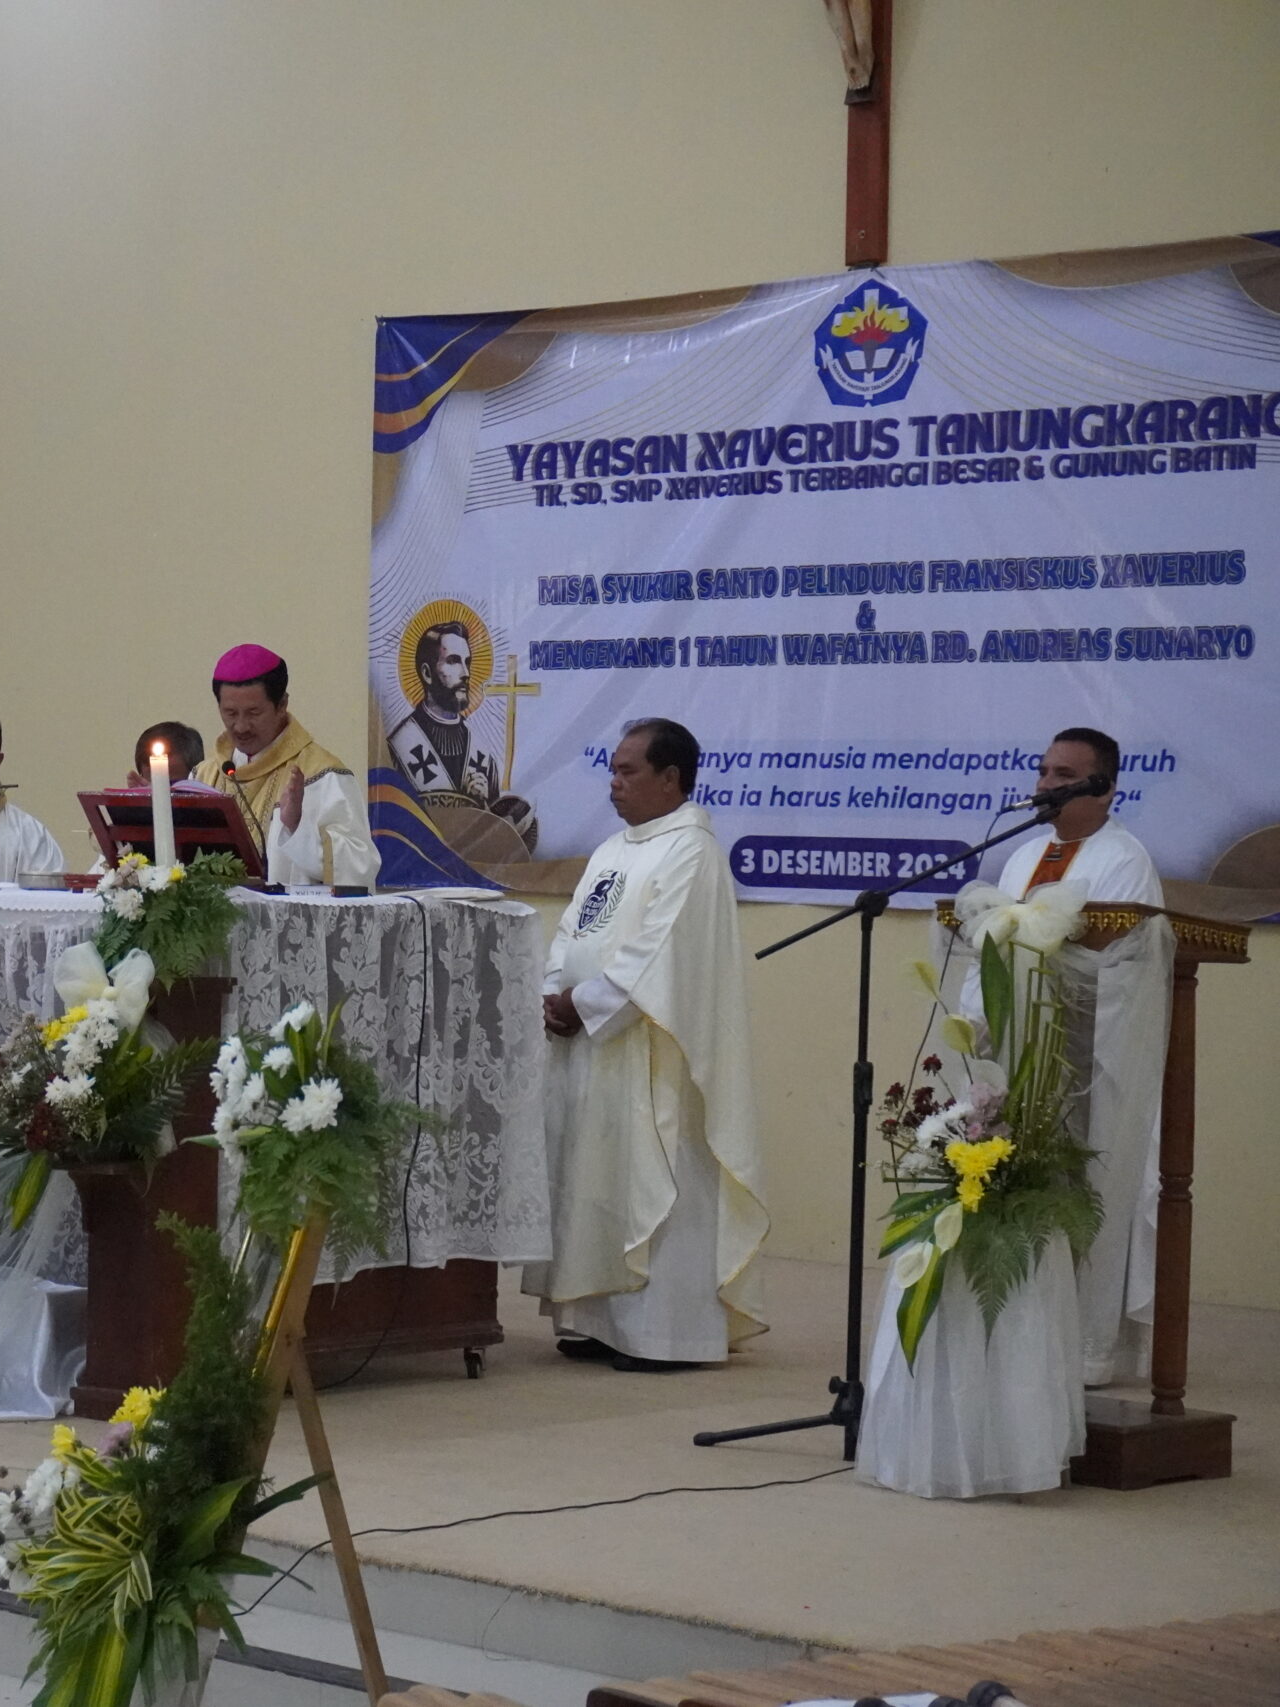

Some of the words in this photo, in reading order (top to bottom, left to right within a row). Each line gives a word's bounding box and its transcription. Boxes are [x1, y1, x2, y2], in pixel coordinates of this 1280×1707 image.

[505, 433, 688, 481] YAYASAN
[695, 418, 900, 472] XAVERIUS
[610, 478, 663, 503] SMP
[665, 470, 783, 501] XAVERIUS
[786, 461, 929, 493] TERBANGGI
[931, 457, 1020, 485] BESAR
[1024, 455, 1045, 480] &
[1050, 449, 1167, 478] GUNUNG
[1169, 443, 1257, 473] BATIN
[538, 575, 599, 605] MISA
[601, 569, 695, 602] SYUKUR
[697, 566, 780, 599] SANTO
[782, 561, 925, 597] PELINDUNG
[928, 556, 1098, 592] FRANSISKUS
[1100, 550, 1246, 588] XAVERIUS
[855, 600, 876, 632] &
[529, 637, 676, 670] MENGENANG
[679, 636, 691, 667] 1
[695, 634, 778, 666] TAHUN
[782, 632, 928, 665] WAFATNYA
[931, 630, 977, 662] RD.
[979, 628, 1112, 662] ANDREAS
[1115, 625, 1256, 661] SUNARYO
[759, 746, 866, 769] manusia
[872, 748, 1043, 775] mendapatka
[740, 784, 762, 806] ia
[769, 785, 840, 808] harus
[847, 785, 991, 814] kehilangan
[740, 849, 755, 873] 3
[762, 850, 890, 877] DESEMBER
